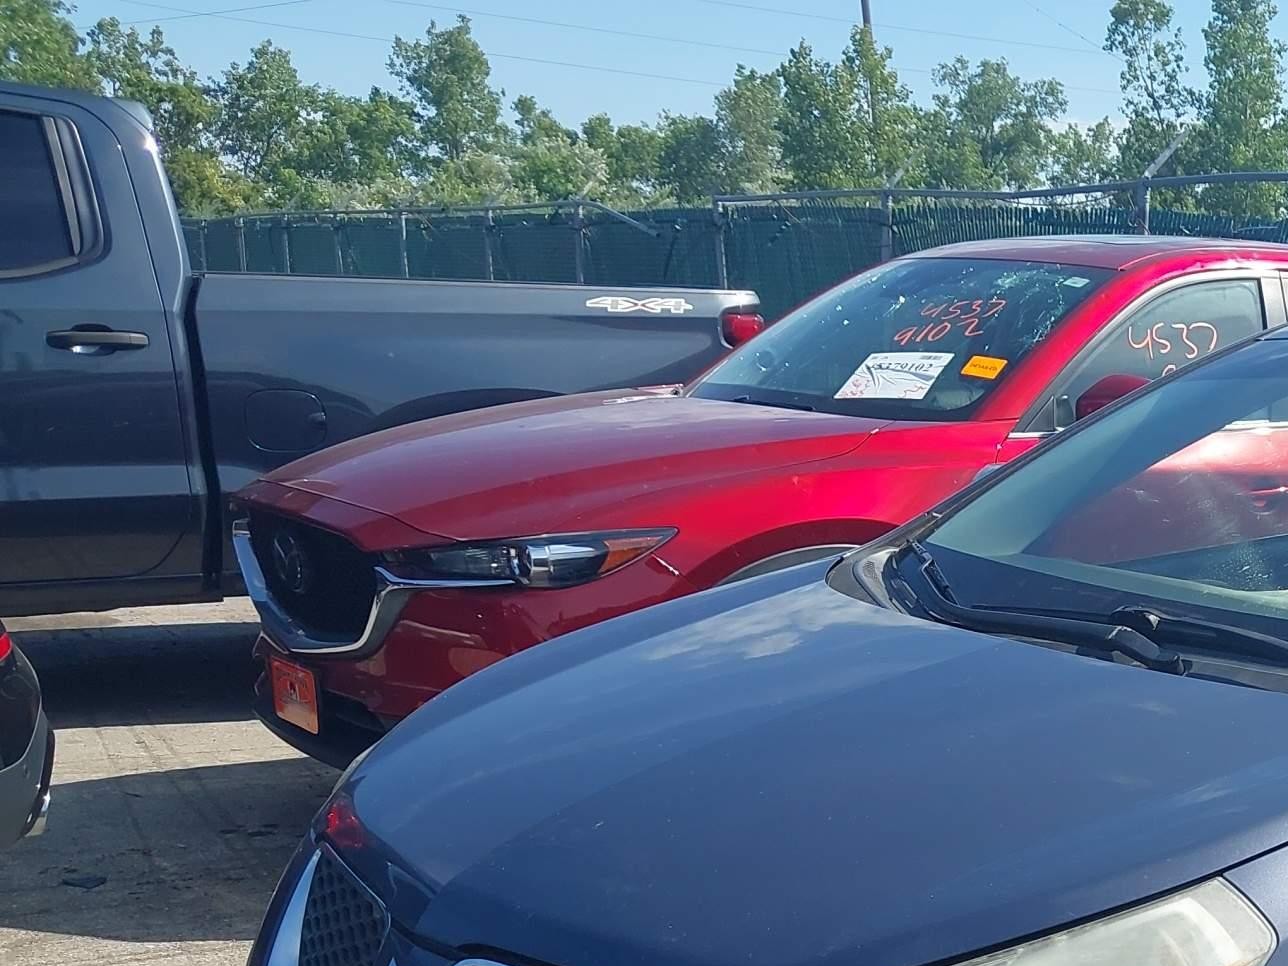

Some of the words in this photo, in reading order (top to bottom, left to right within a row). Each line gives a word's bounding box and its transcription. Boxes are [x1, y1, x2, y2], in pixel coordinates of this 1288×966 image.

[920, 299, 1008, 320] 4537
[893, 317, 985, 346] 9102
[1128, 321, 1218, 360] 4537
